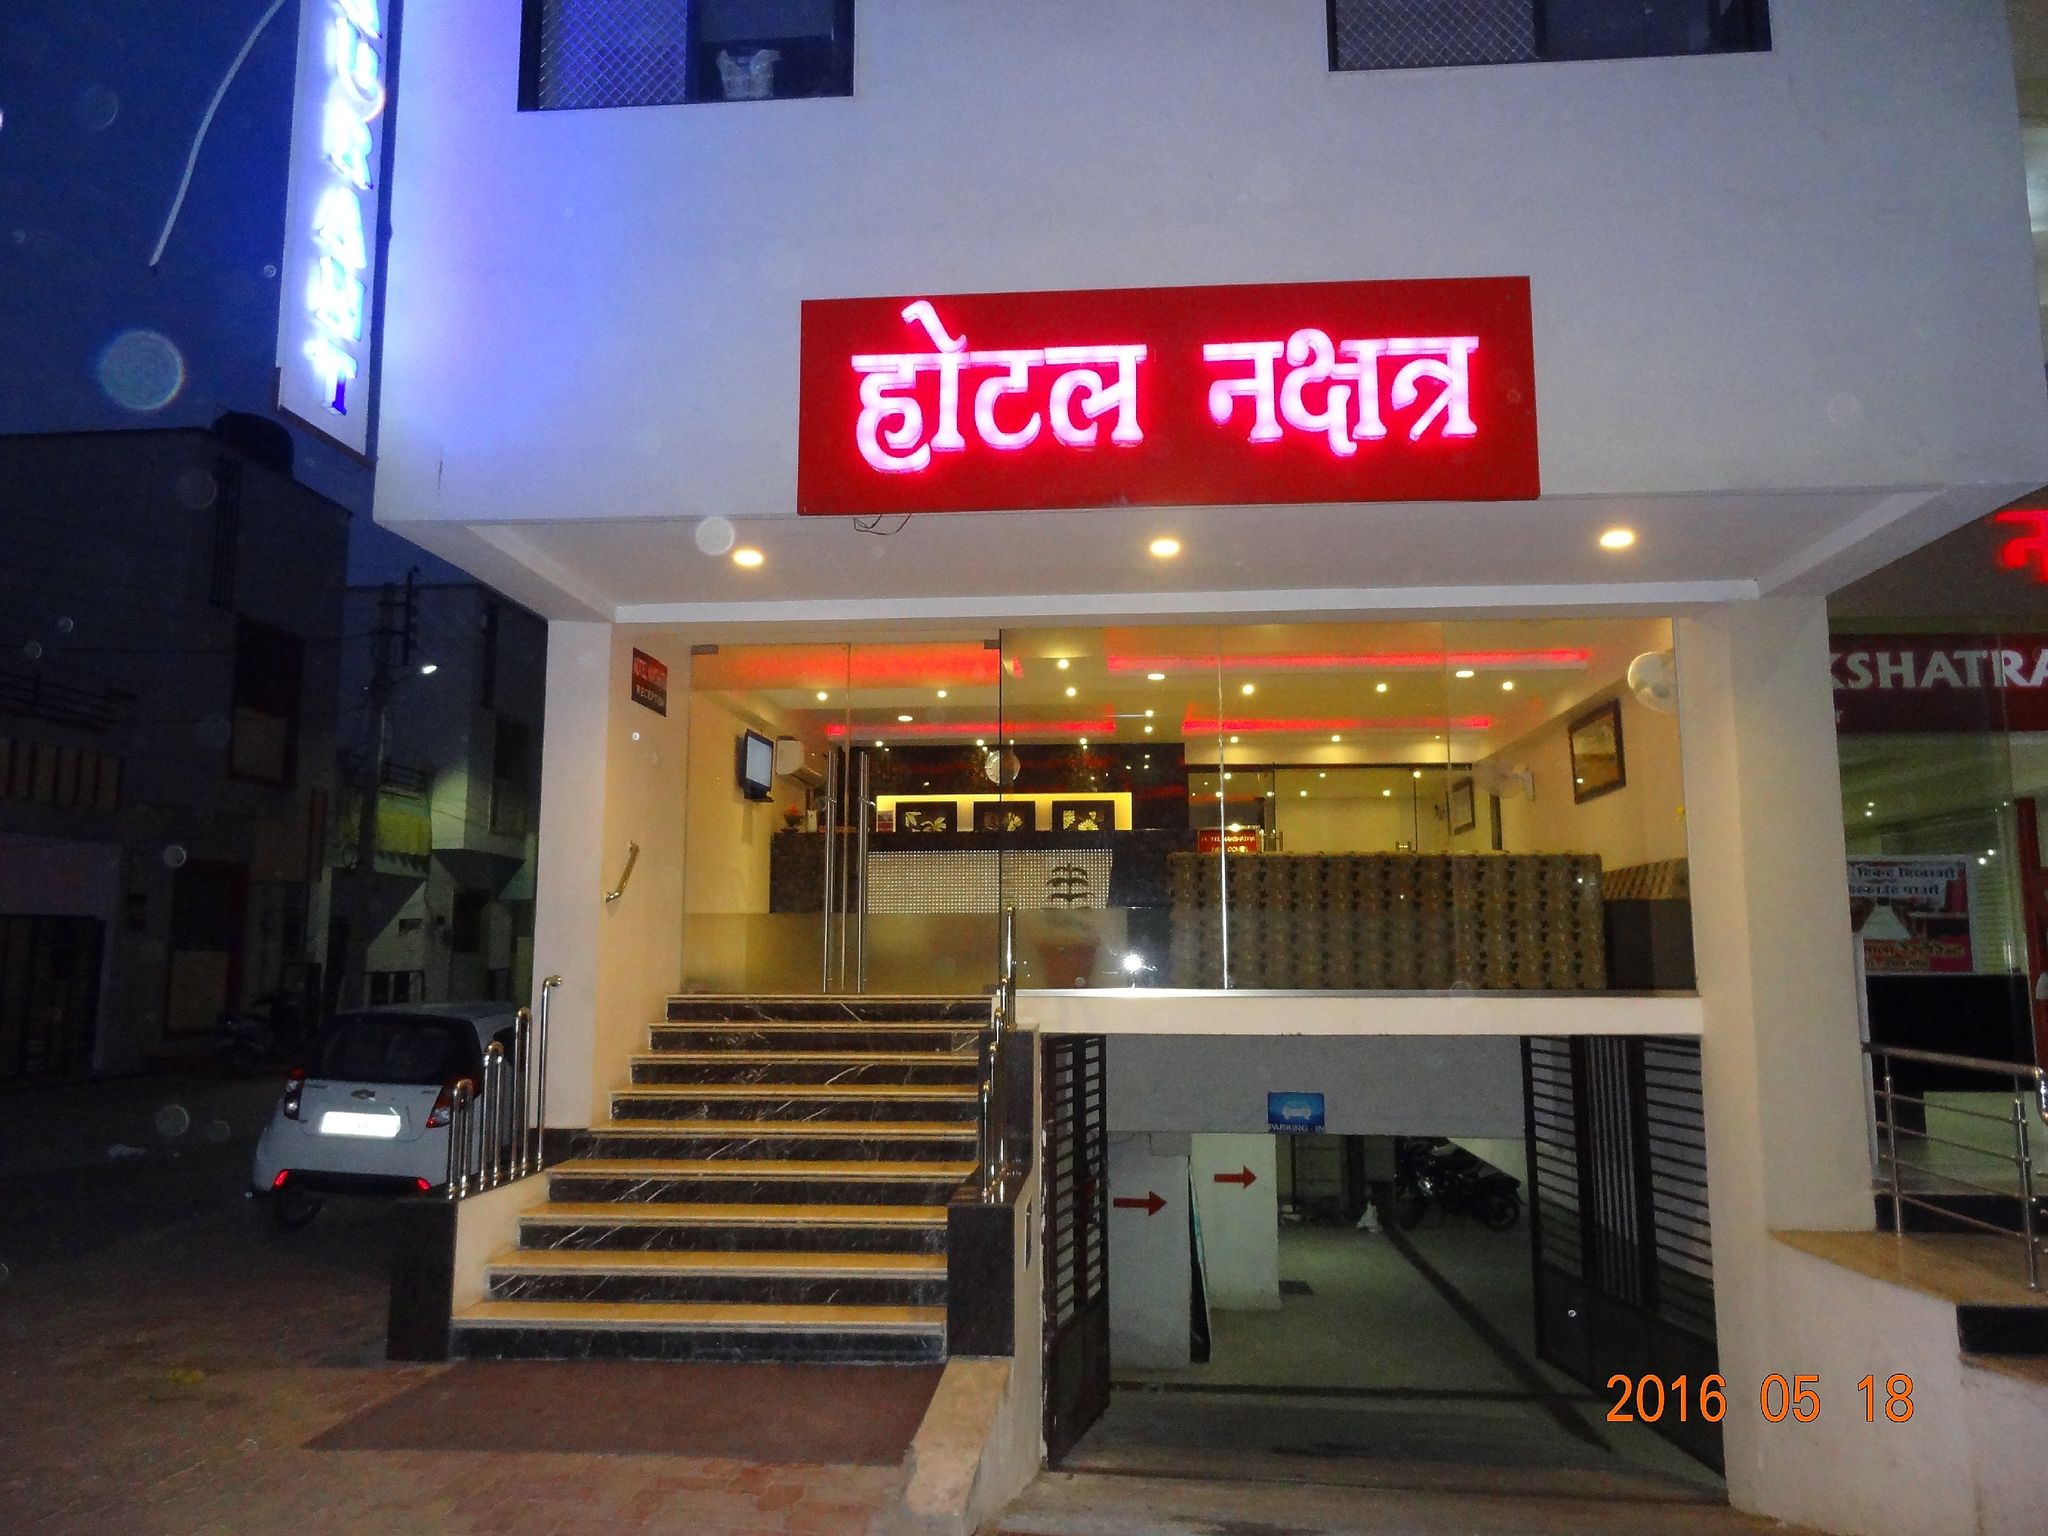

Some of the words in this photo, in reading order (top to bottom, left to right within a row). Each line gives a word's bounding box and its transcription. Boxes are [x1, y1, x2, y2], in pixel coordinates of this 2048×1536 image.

[851, 300, 1148, 473] होटल
[1203, 327, 1479, 457] नक्षत्र
[1266, 1123, 1308, 1132] PARKING
